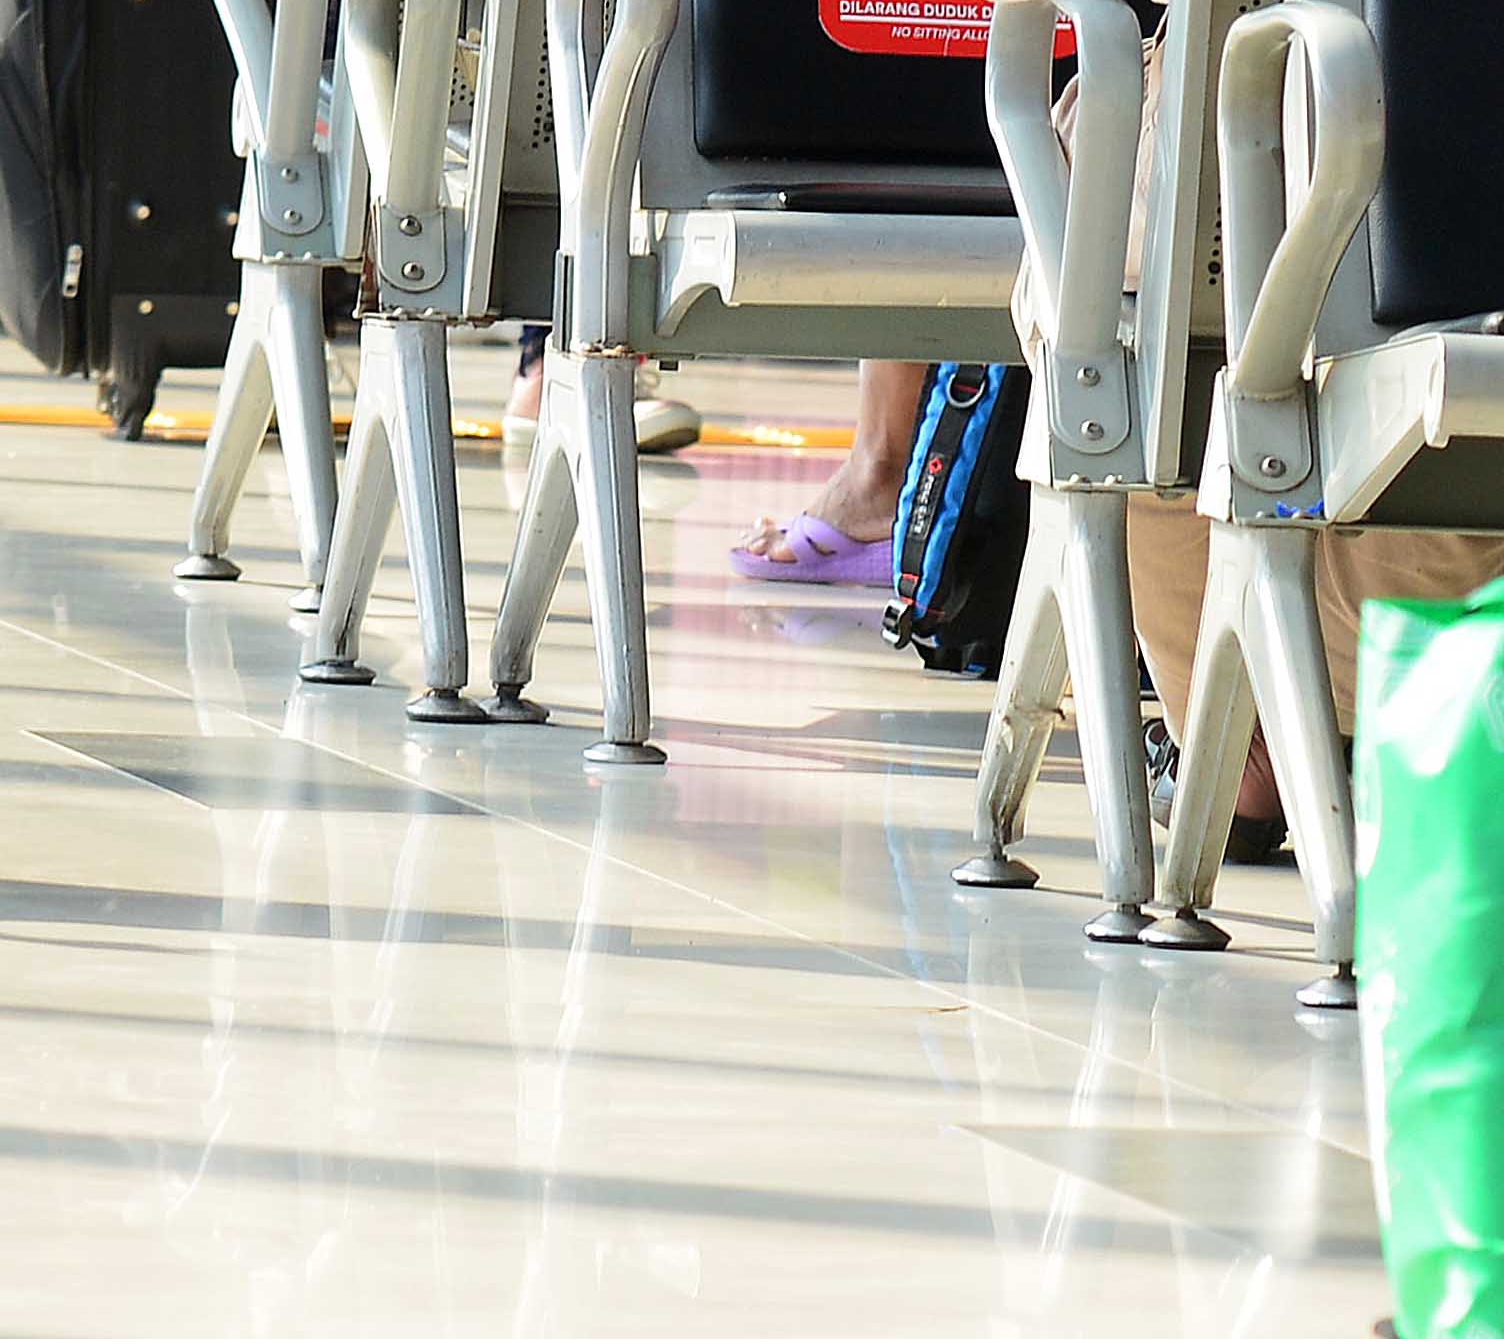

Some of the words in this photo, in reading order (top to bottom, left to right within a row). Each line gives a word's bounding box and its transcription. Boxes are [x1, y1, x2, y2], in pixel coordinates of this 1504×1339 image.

[840, 0, 921, 16] DILARANG
[923, 3, 978, 19] DUDUK
[891, 26, 911, 38] NO
[912, 27, 960, 40] SITTING
